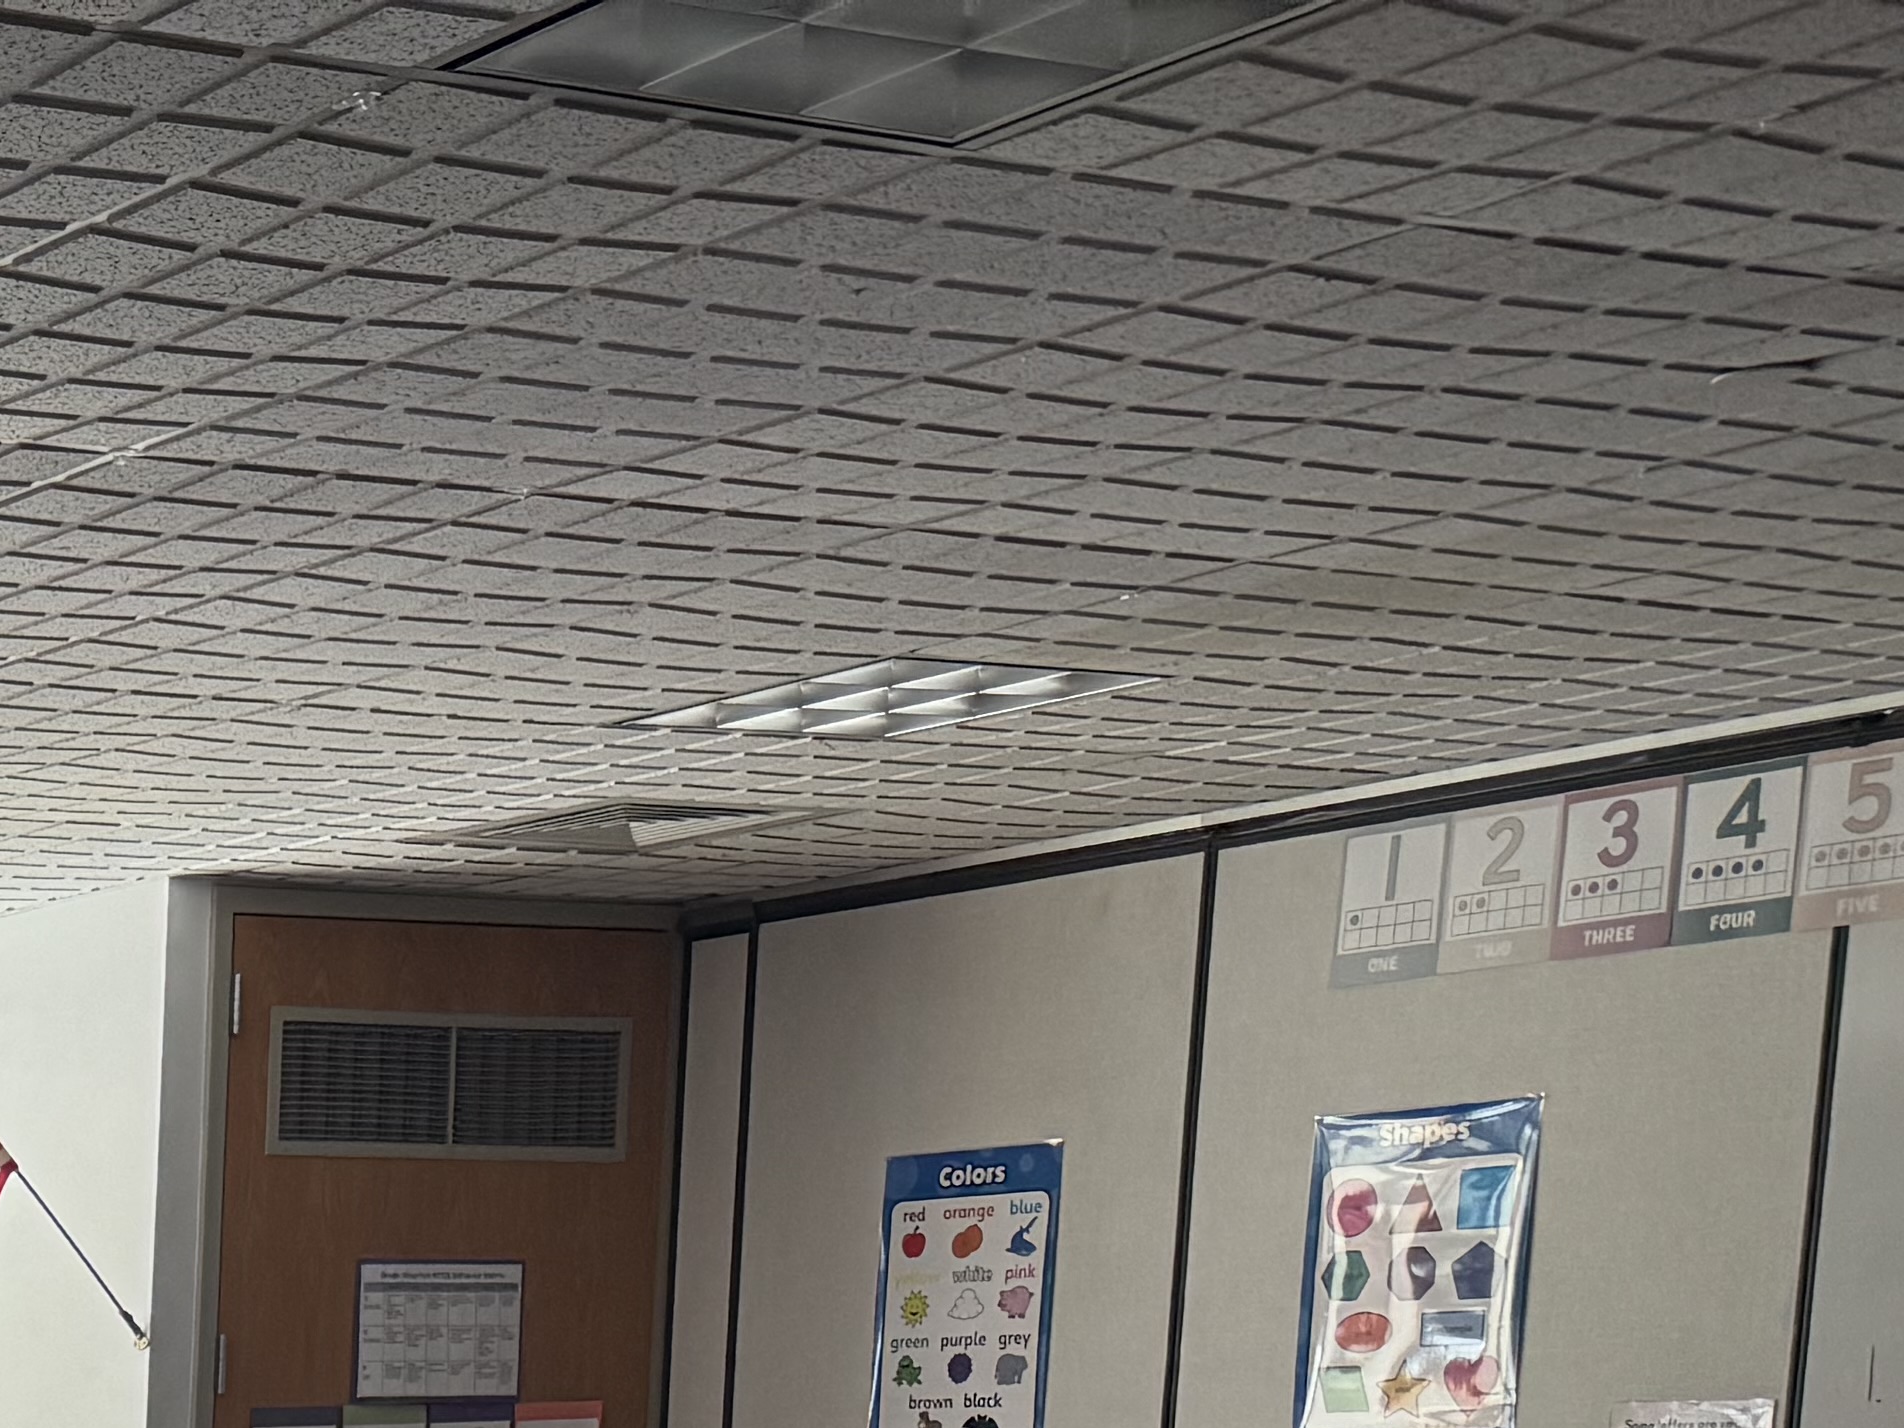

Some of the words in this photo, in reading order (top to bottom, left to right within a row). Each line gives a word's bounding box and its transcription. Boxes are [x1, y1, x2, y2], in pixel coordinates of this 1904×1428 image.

[1841, 756, 1894, 834] 5
[1715, 776, 1766, 849] 4
[1596, 798, 1640, 868] 3
[1482, 815, 1525, 887] 2
[1385, 834, 1402, 901] 1
[1835, 894, 1880, 916] FIVE
[1708, 909, 1756, 931] FOUR
[1583, 925, 1636, 947] THREE
[1367, 955, 1399, 973] ONE
[1379, 1120, 1471, 1148] Shapes
[939, 1164, 1006, 1187] Colors
[903, 1207, 926, 1223] red
[943, 1205, 995, 1222] orange
[1010, 1200, 1043, 1215] blue
[1004, 1264, 1036, 1284] pink
[890, 1337, 929, 1352] green
[940, 1331, 987, 1351] purple
[998, 1333, 1031, 1350] grey
[908, 1394, 953, 1409] brown
[964, 1393, 1003, 1408] black
